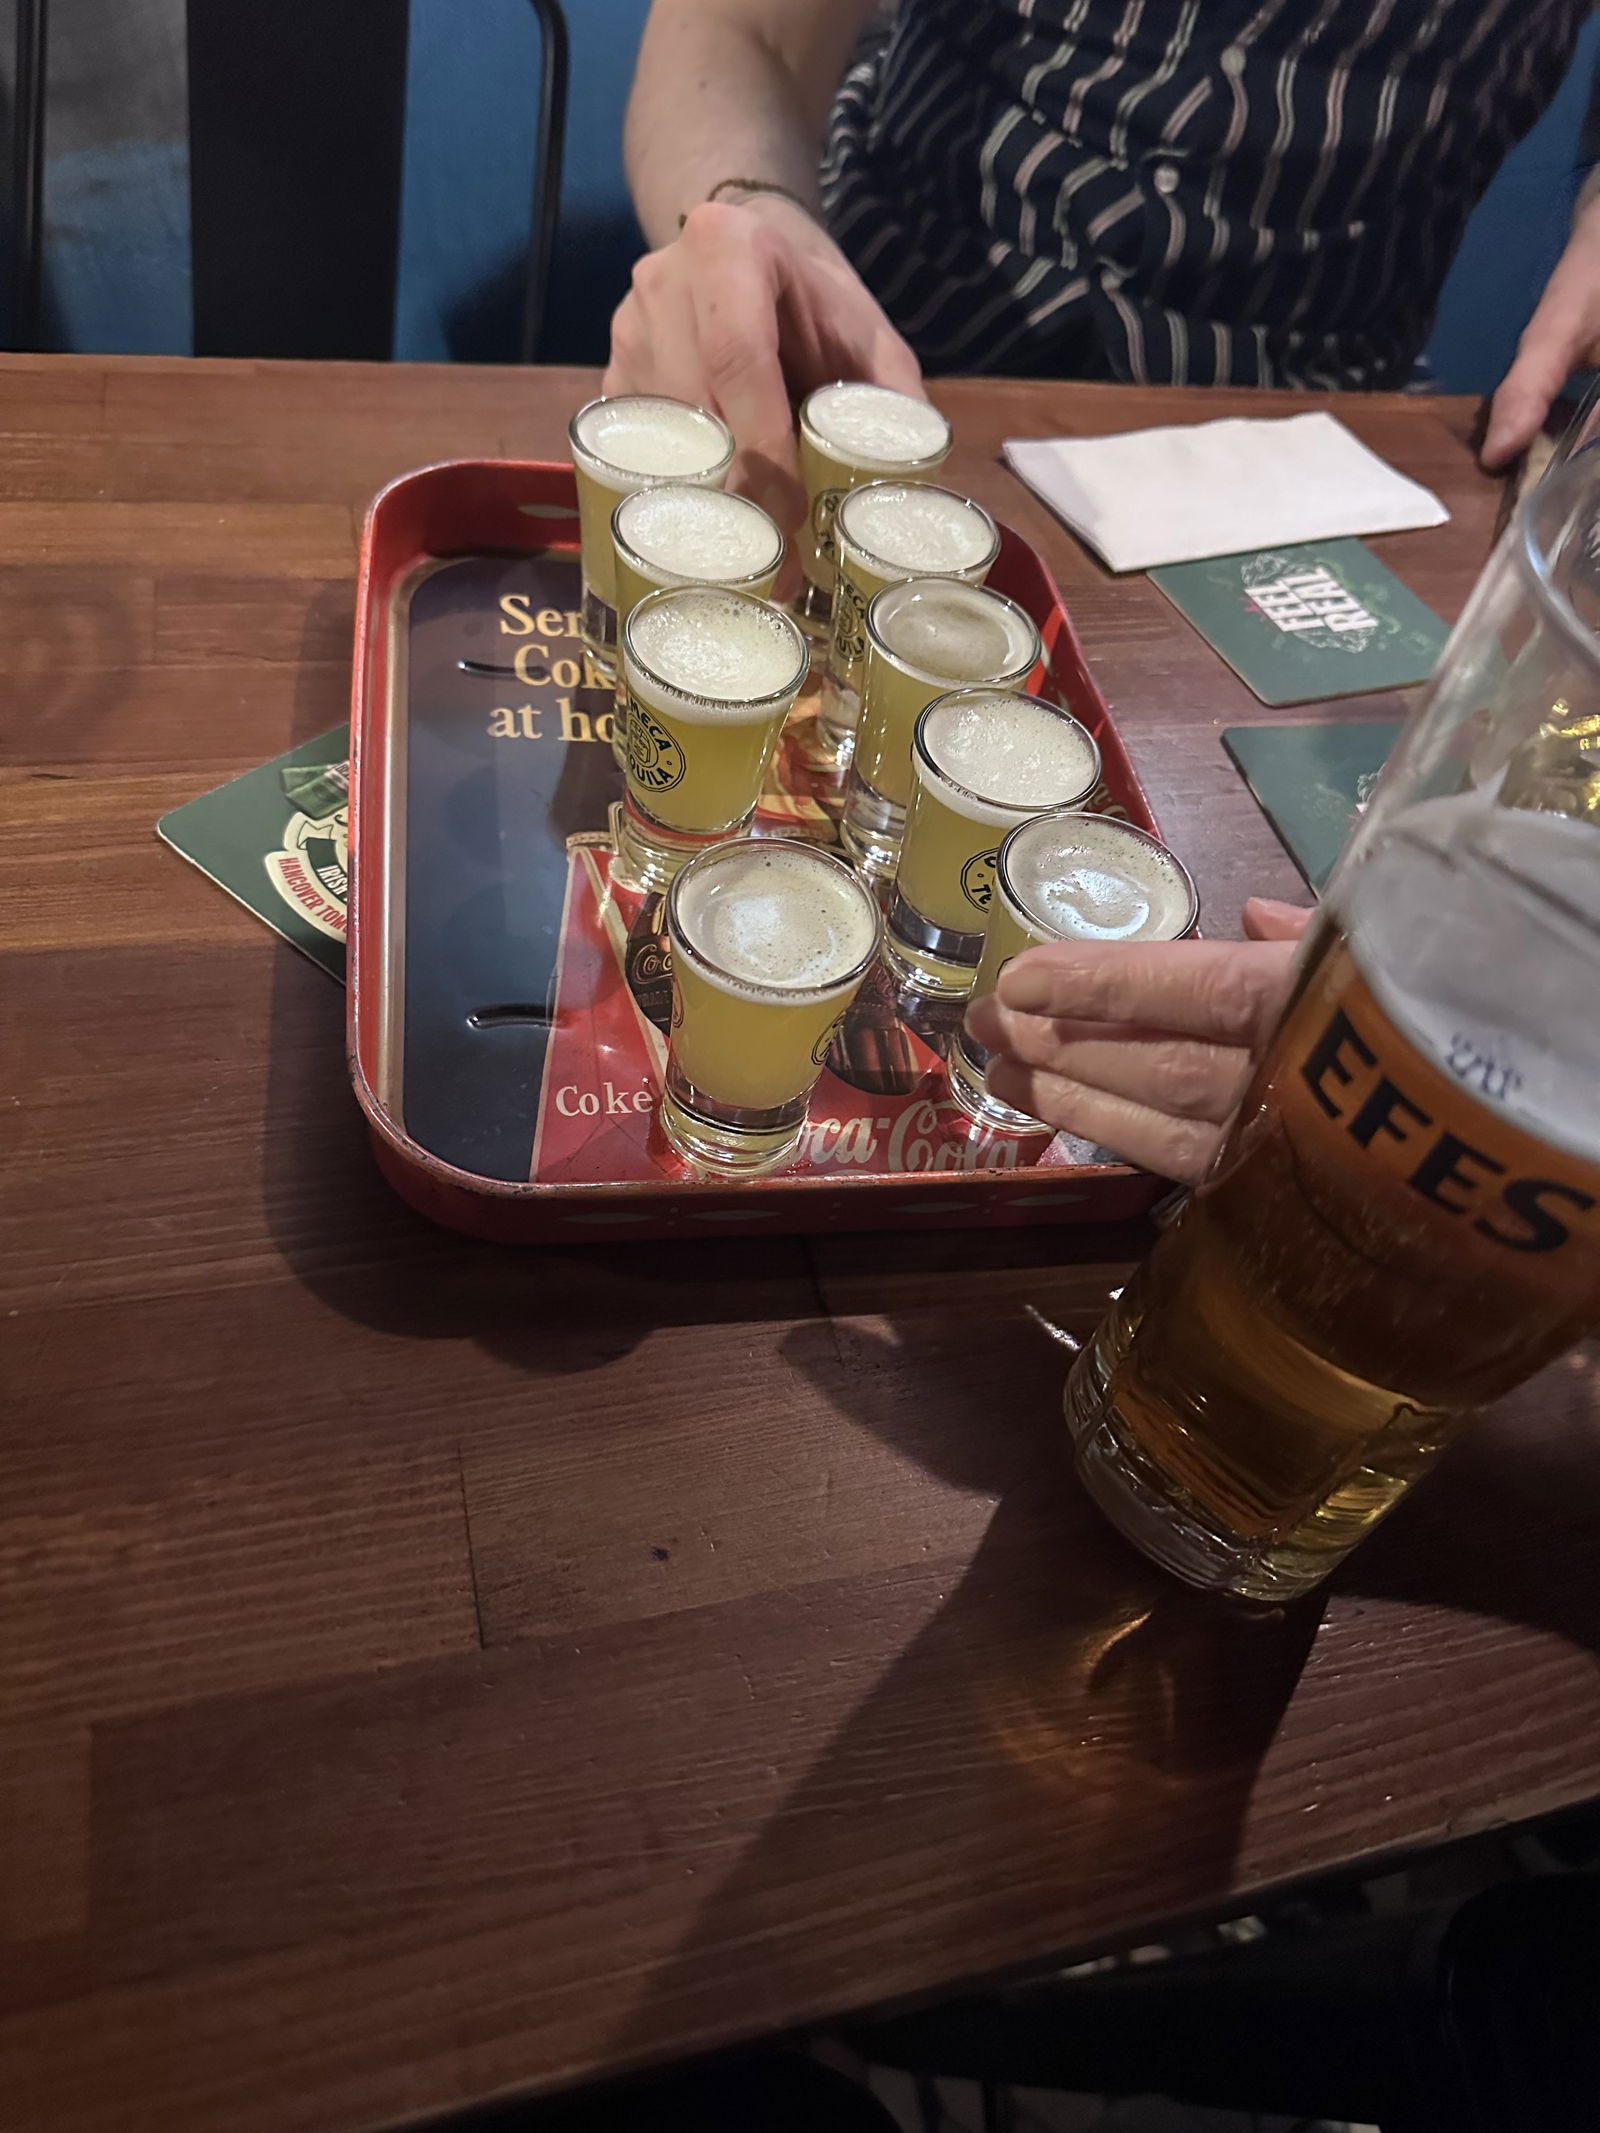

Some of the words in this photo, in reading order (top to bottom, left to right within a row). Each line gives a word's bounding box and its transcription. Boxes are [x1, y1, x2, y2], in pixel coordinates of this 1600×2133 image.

[499, 592, 583, 638] Ser
[1244, 579, 1326, 632] FEEL
[1281, 566, 1379, 632] REAL
[513, 643, 617, 690] Cok
[486, 704, 543, 739] at
[555, 696, 615, 744] ho
[630, 697, 672, 751] MECA
[629, 754, 674, 786] QUILA
[278, 857, 325, 910] HANGOVER
[555, 1081, 653, 1117] Coke
[1299, 1005, 1597, 1254] EFES
